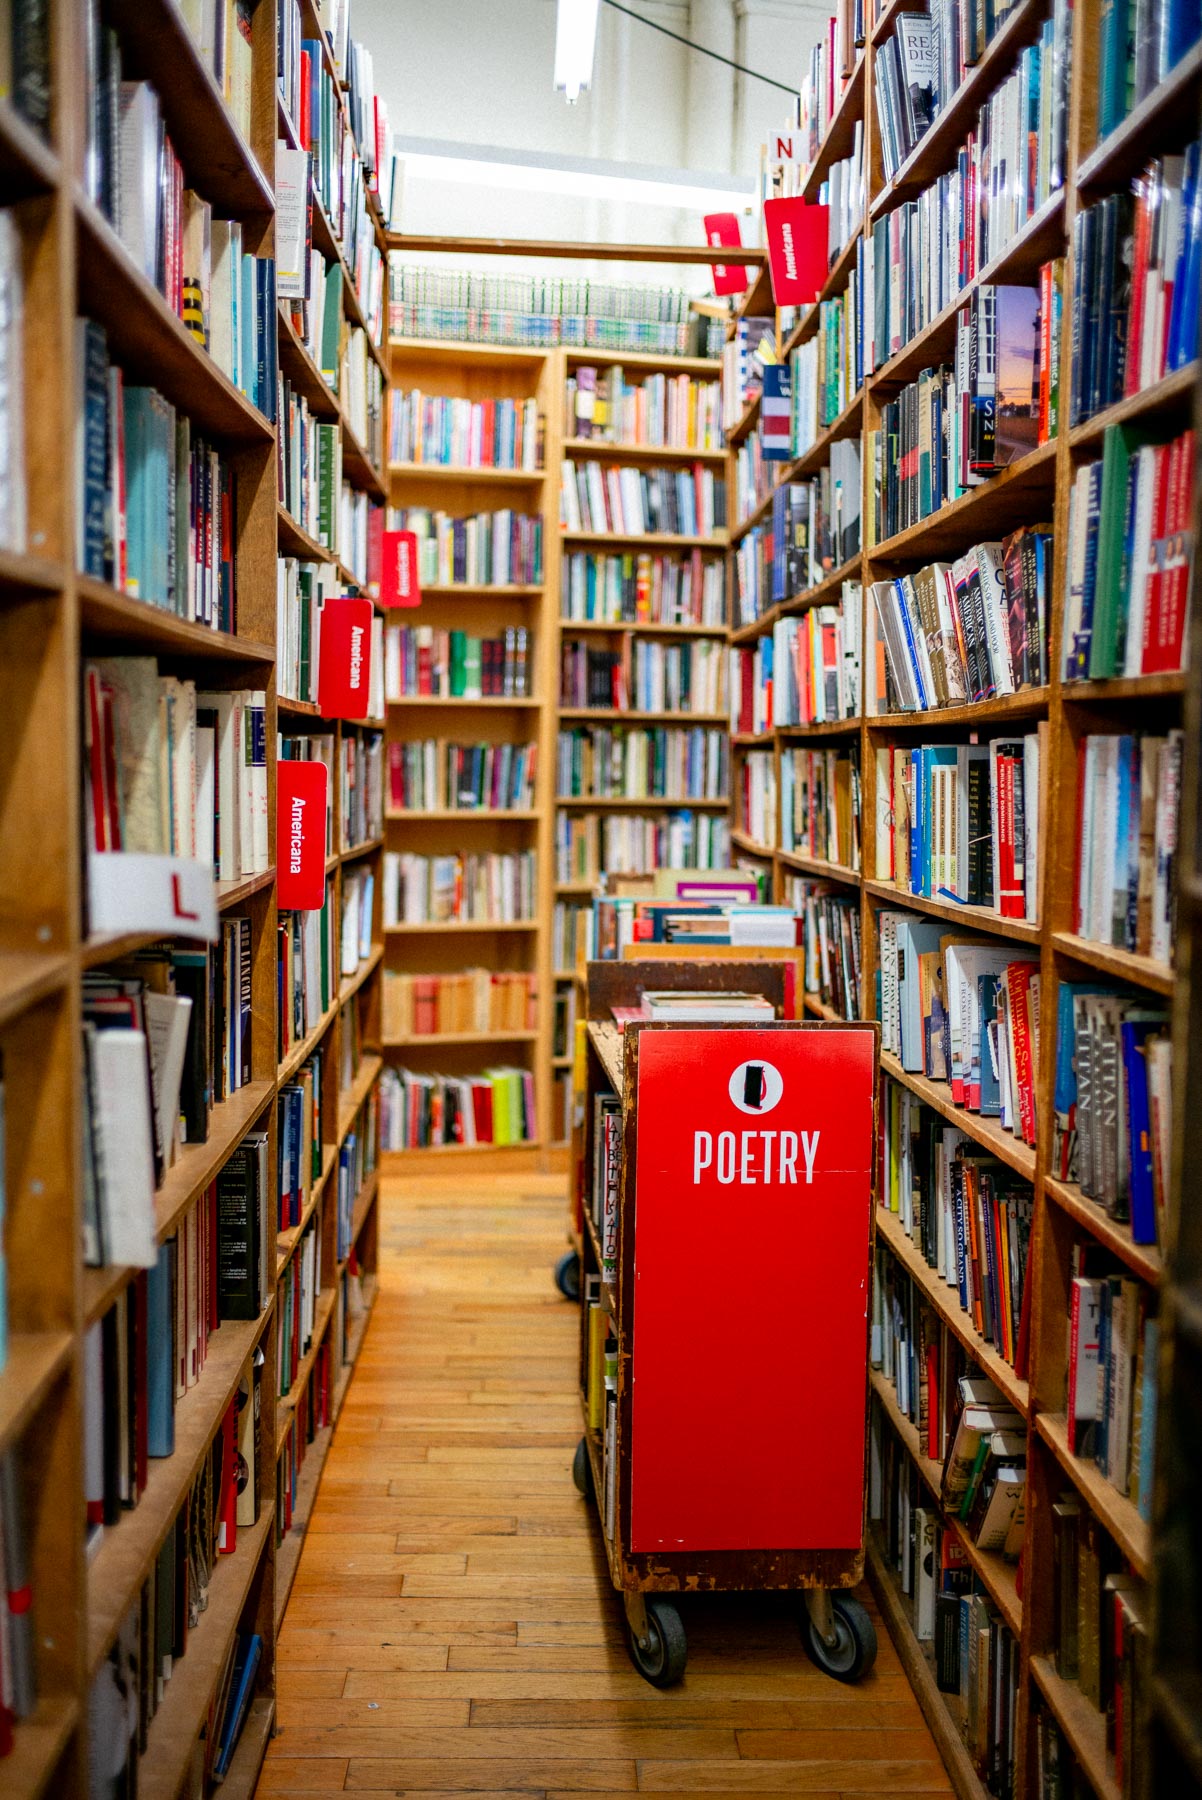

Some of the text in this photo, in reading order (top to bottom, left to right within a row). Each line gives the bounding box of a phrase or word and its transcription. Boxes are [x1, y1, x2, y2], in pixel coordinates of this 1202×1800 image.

[777, 137, 793, 159] N
[782, 222, 798, 281] Americana
[1051, 340, 1059, 388] AMERICA
[962, 595, 975, 648] AMERICAN
[973, 586, 985, 643] AMERICAN
[989, 619, 997, 634] AND
[350, 625, 364, 689] Americana
[991, 634, 999, 654] POOR
[1000, 789, 1005, 799] OF
[1007, 791, 1012, 801] OF
[290, 796, 307, 874] Americana
[171, 873, 198, 921] L
[240, 951, 252, 1014] LINCOLN
[1031, 983, 1039, 1028] AMERICAN
[1014, 970, 1028, 1047] Fortunate
[1020, 1050, 1029, 1083] Son
[1078, 1028, 1091, 1111] TITAN
[1102, 1040, 1117, 1128] TITAN
[692, 1131, 819, 1184] POETRY
[957, 1226, 963, 1241] SO
